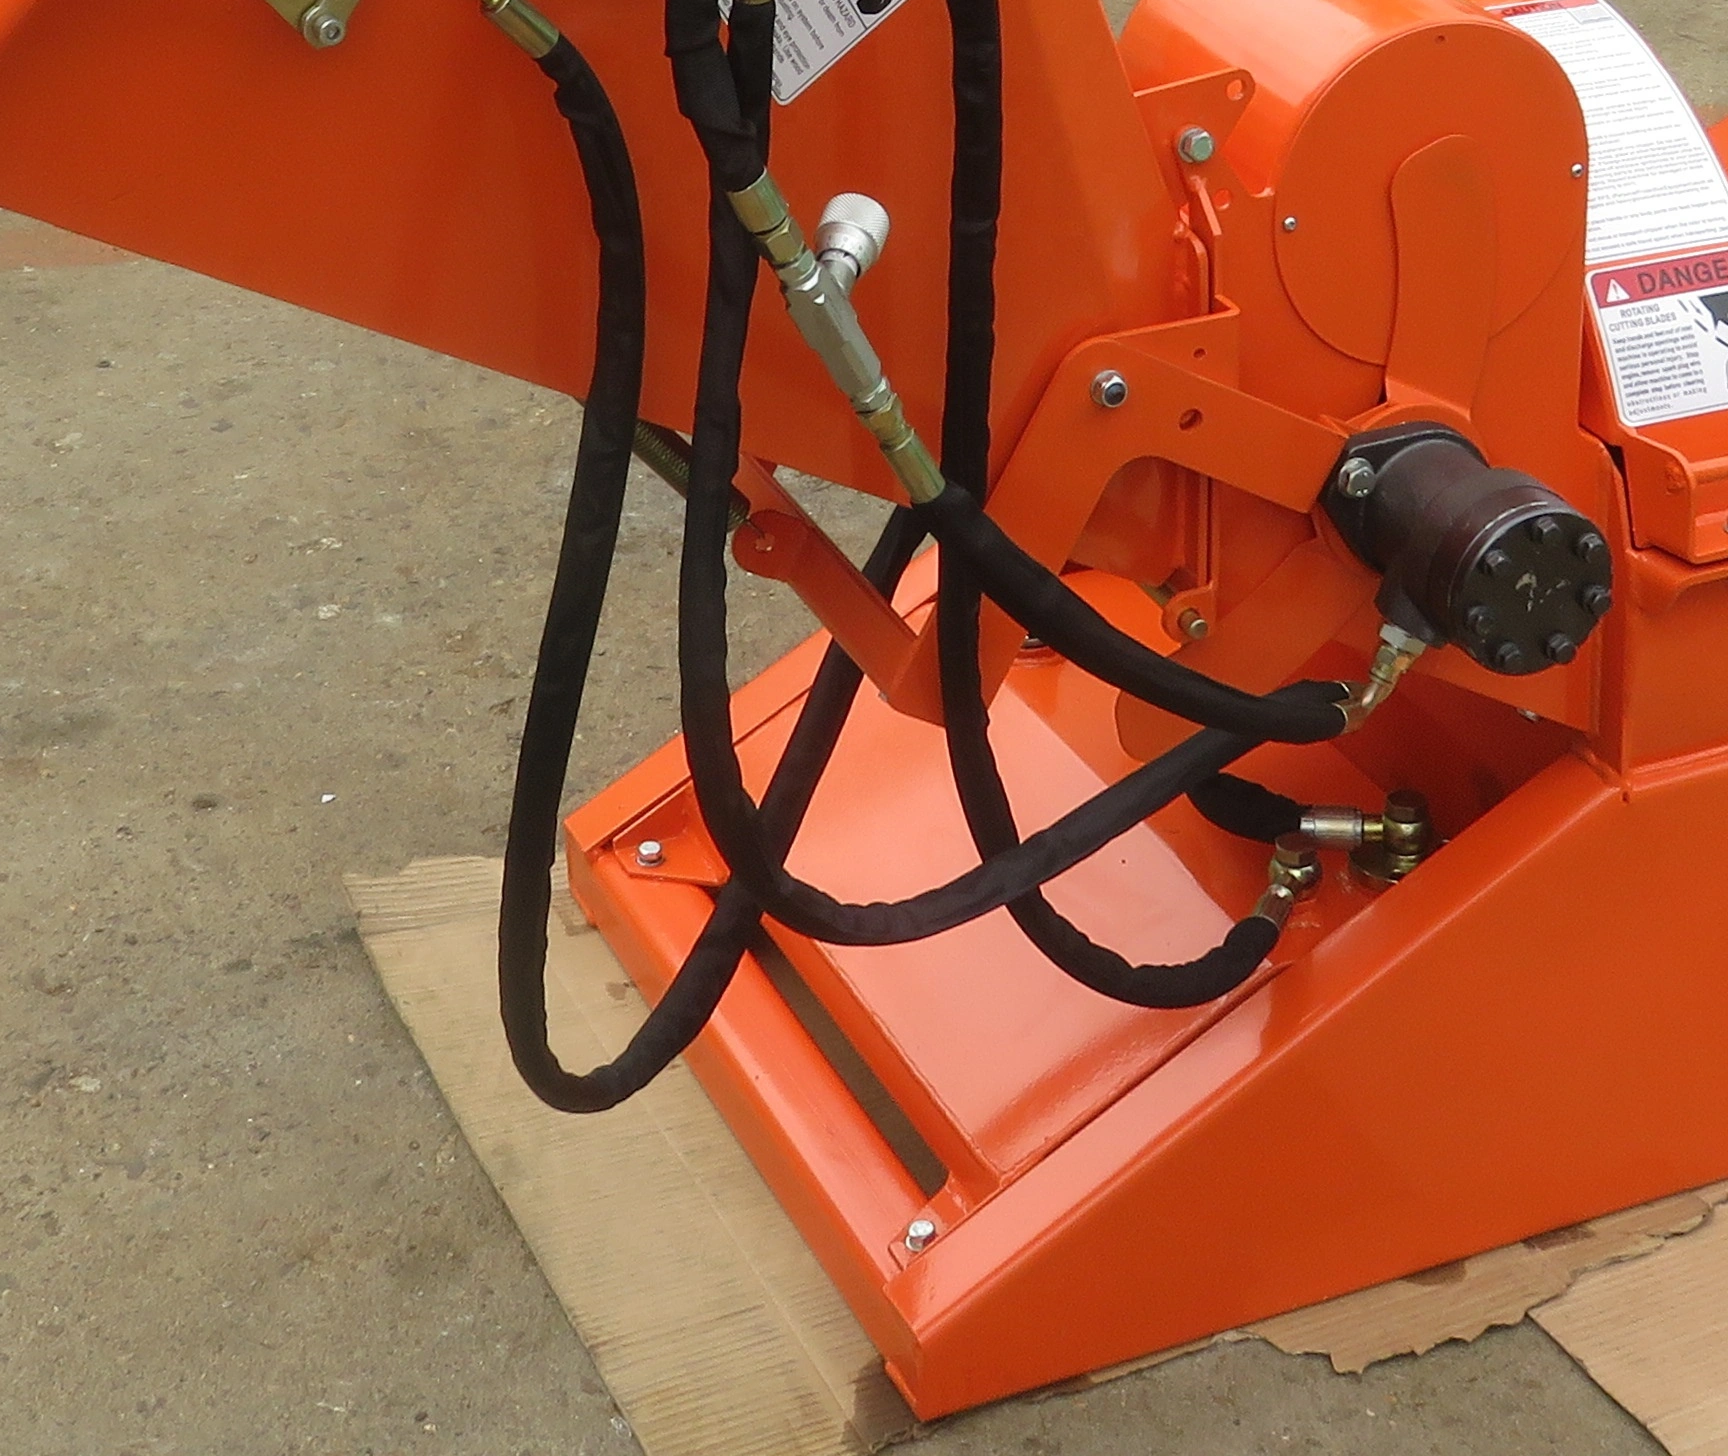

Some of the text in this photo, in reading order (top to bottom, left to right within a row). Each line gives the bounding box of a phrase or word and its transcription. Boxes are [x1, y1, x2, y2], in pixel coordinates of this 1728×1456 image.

[834, 0, 855, 28] HAZARD
[1619, 303, 1660, 318] ROTATING
[1608, 312, 1676, 332] CUTTING BLADES
